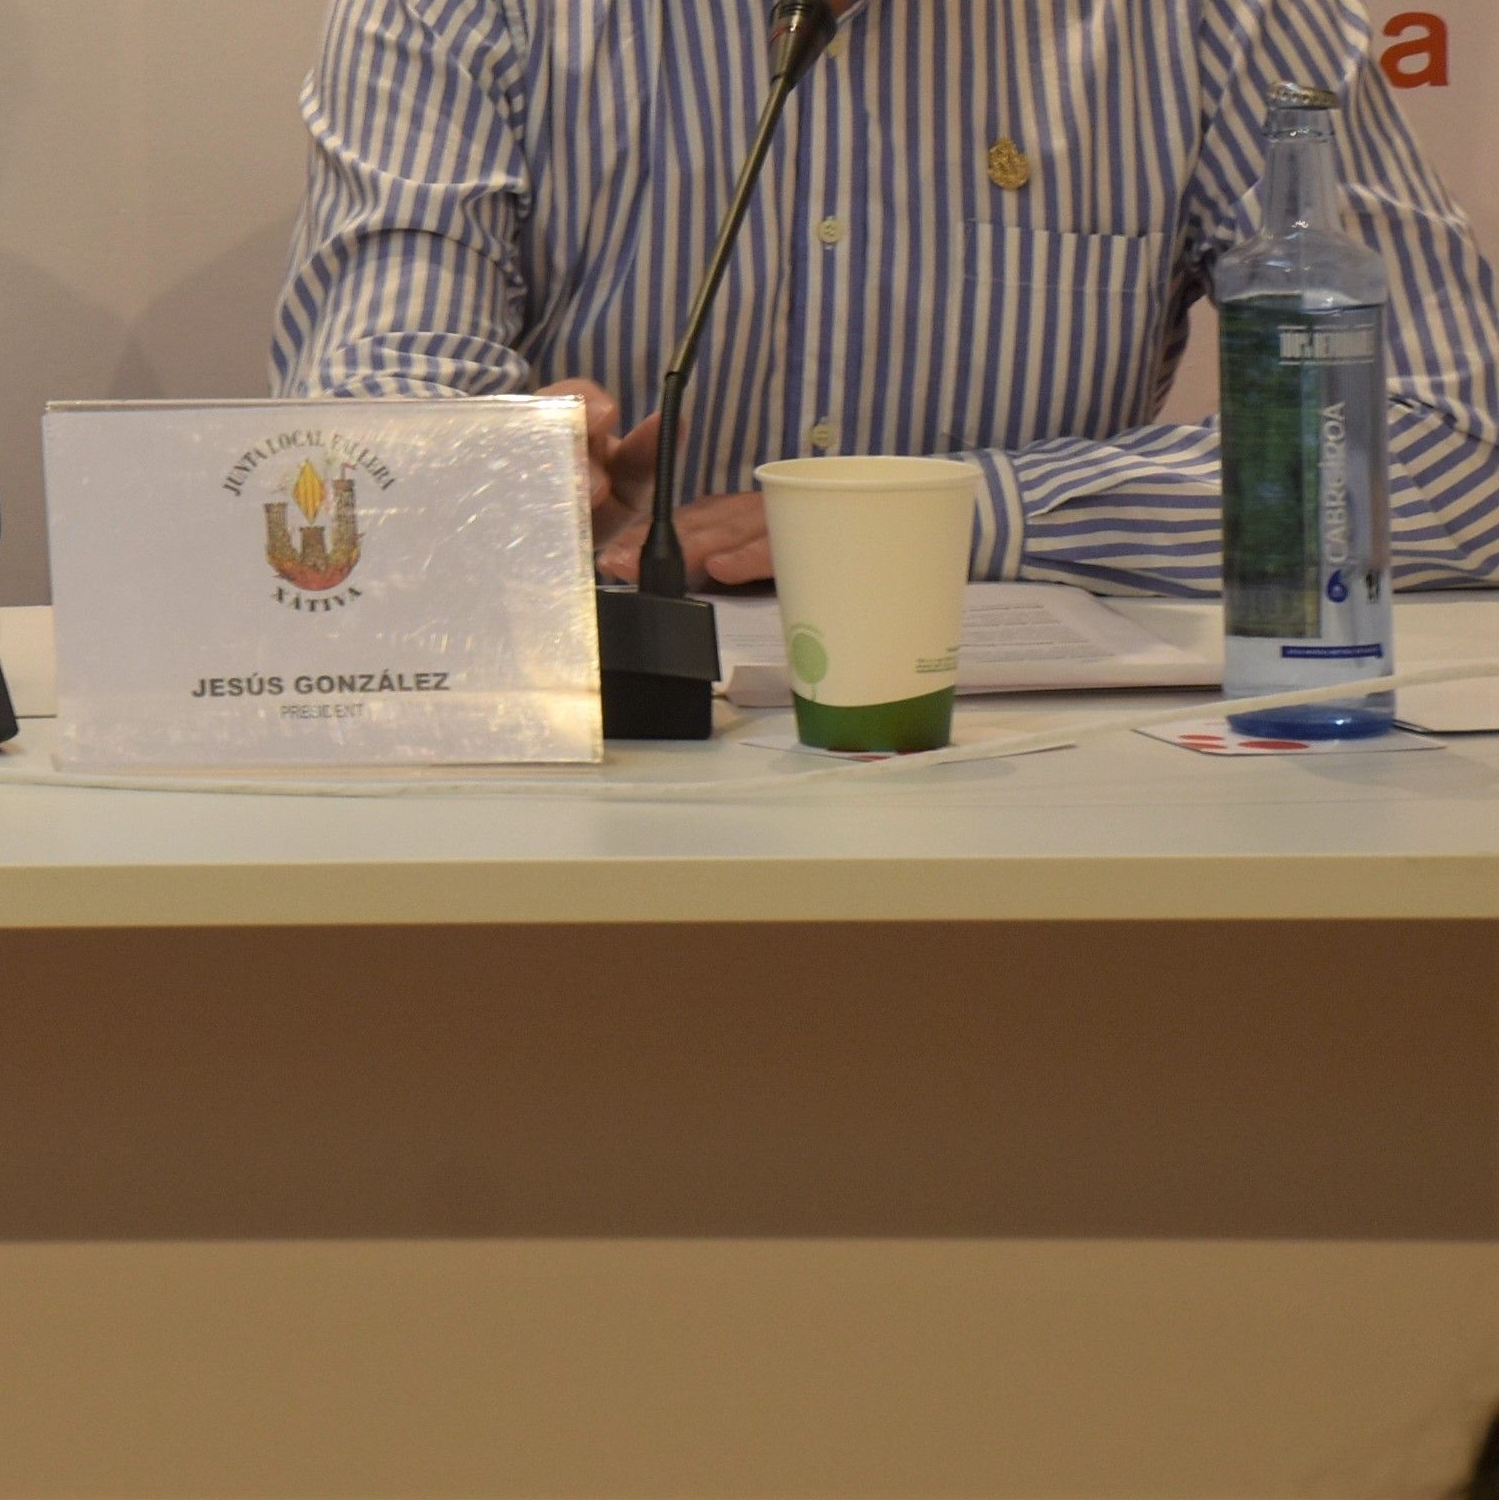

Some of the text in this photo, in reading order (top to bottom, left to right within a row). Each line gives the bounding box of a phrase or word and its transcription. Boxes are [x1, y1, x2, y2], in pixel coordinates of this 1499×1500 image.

[222, 446, 268, 497] JUNTA
[264, 429, 326, 455] LOCAL
[191, 668, 451, 698] JESÚS GONZÁLEZ
